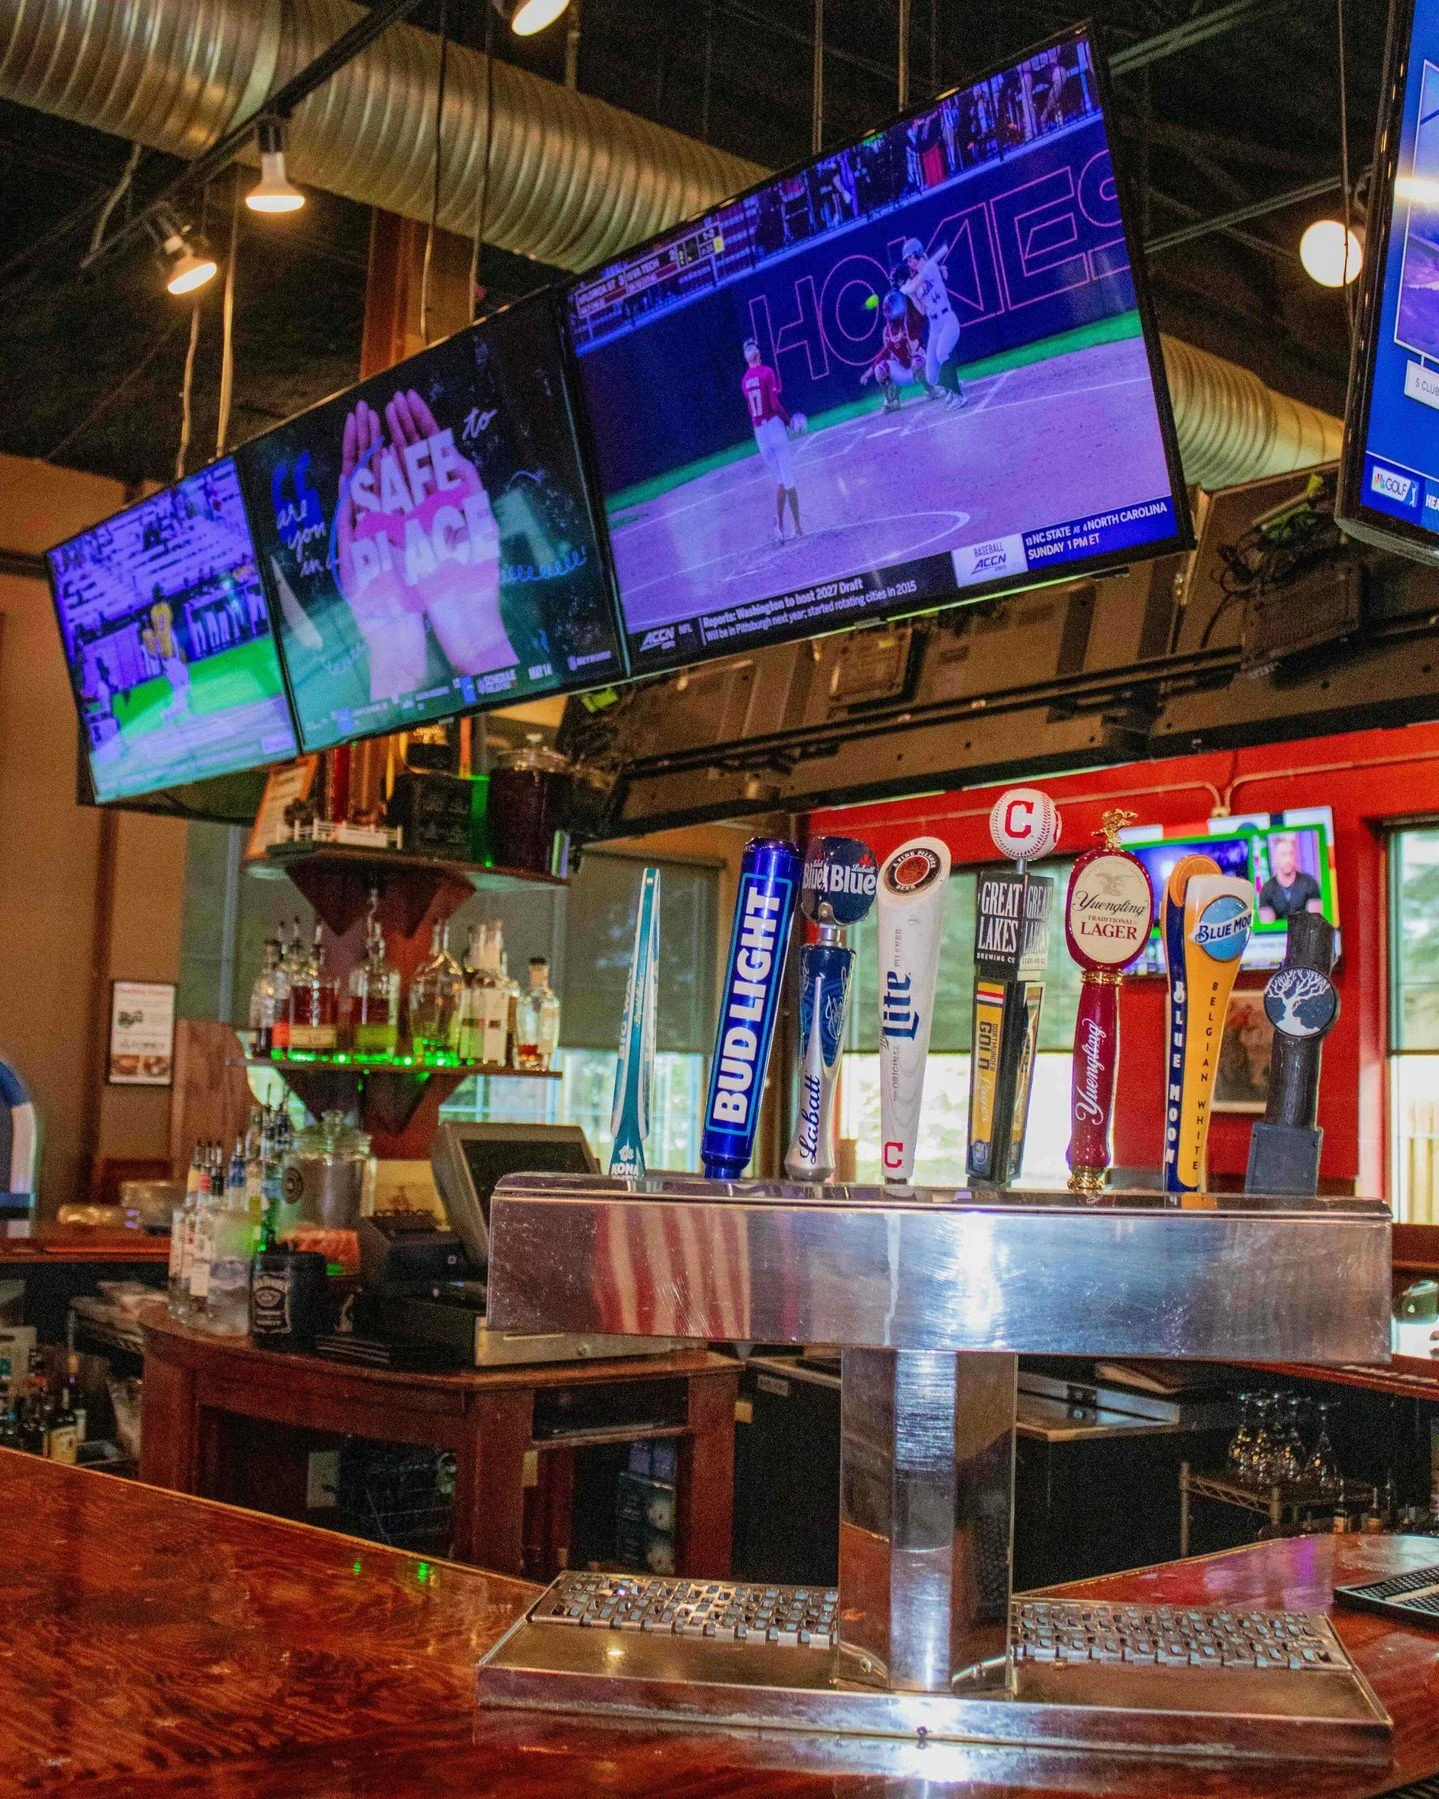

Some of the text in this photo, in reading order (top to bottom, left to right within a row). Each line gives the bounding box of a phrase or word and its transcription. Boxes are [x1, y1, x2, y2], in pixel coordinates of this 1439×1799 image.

[350, 428, 463, 515] SAFE
[1385, 477, 1407, 496] GOLF
[350, 489, 501, 587] PLACE
[1033, 532, 1046, 545] NC
[1046, 526, 1071, 541] STATE
[1087, 513, 1120, 531] NORTH
[1119, 502, 1168, 522] CAROLINA
[974, 542, 1004, 557] BASEBALL
[974, 554, 1007, 570] ACCN
[1027, 533, 1100, 560] SUNDAY 1 PM ET
[736, 600, 785, 620] Washington
[795, 588, 816, 605] host
[816, 582, 838, 600] 2027
[839, 577, 864, 594] Draft
[807, 600, 834, 617] started
[835, 594, 866, 611] rotating
[887, 586, 896, 597] in
[895, 580, 917, 596] 2015
[1005, 800, 1034, 838] C
[830, 864, 876, 896] Blue
[982, 881, 1022, 917] GREAT
[1072, 890, 1148, 917] Yuengling
[978, 915, 1018, 953] LAKES
[1080, 921, 1138, 940] LAGER
[1195, 921, 1231, 943] BLUE
[976, 952, 1005, 963] BREWING
[713, 886, 781, 1123] BUD LIGHT
[884, 970, 920, 1042] Lite
[1172, 980, 1186, 1069] BLUE
[1075, 1018, 1106, 1125] Yuengling
[1193, 982, 1219, 1171] BELGIAN WHITE
[799, 1073, 822, 1165] Labatt
[1165, 1084, 1181, 1164] MOON
[611, 1162, 639, 1177] KONA
[884, 1141, 904, 1169] C
